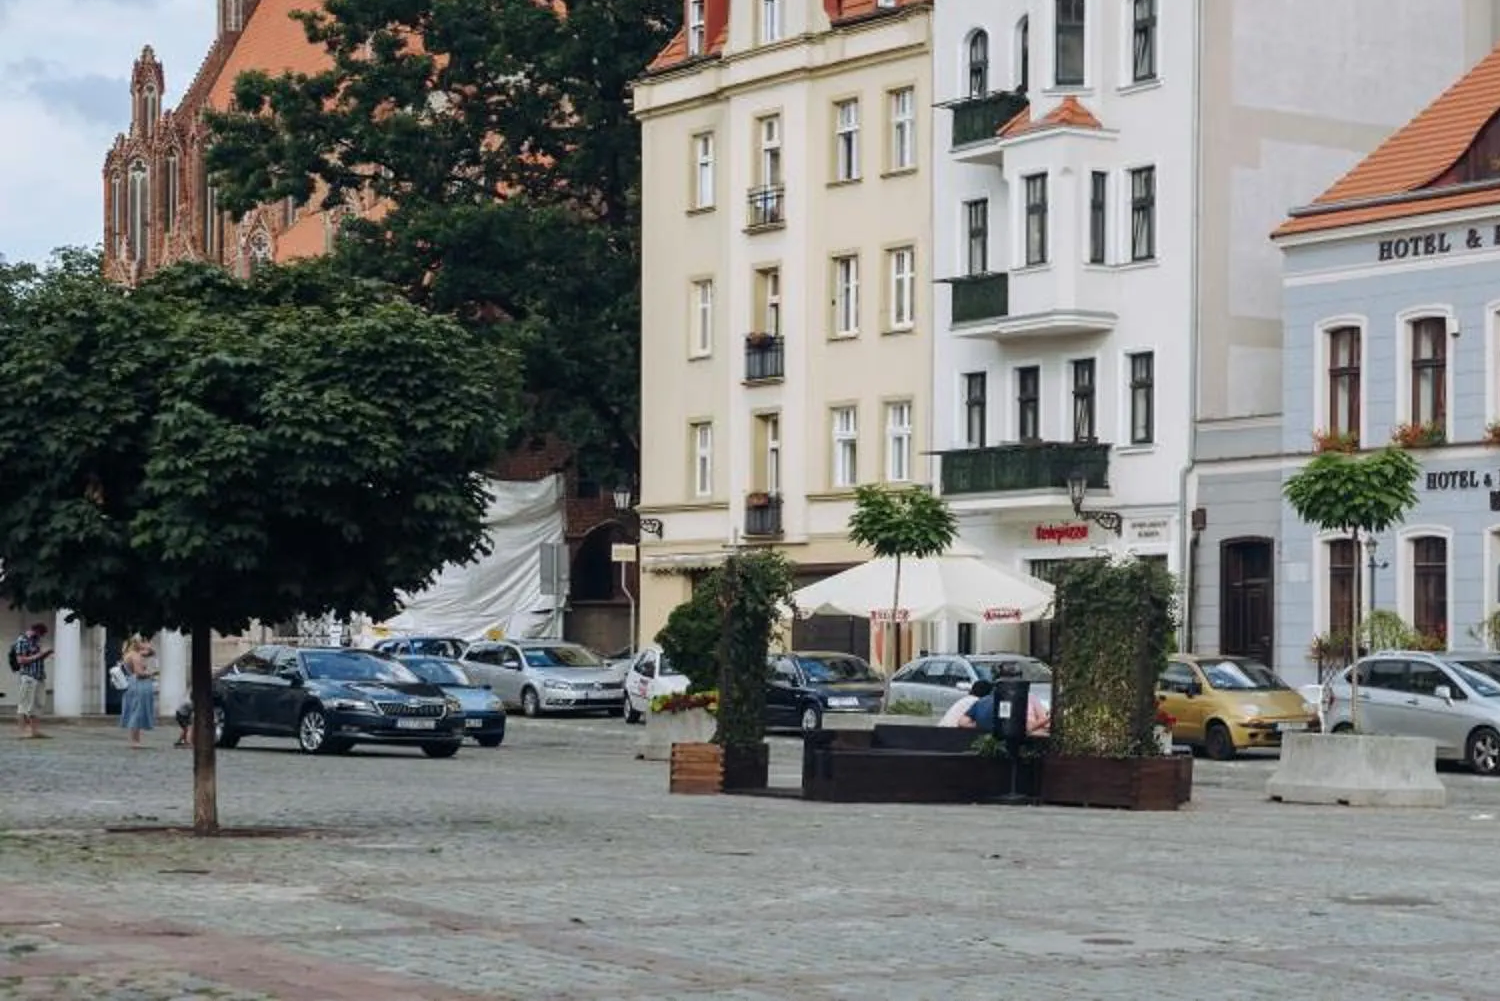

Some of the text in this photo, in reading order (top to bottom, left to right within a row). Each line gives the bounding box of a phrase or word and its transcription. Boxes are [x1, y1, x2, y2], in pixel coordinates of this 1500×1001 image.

[1378, 231, 1451, 262] HOTEL
[1466, 228, 1483, 249] &
[1426, 471, 1479, 490] HOTEL
[1483, 473, 1493, 488] &
